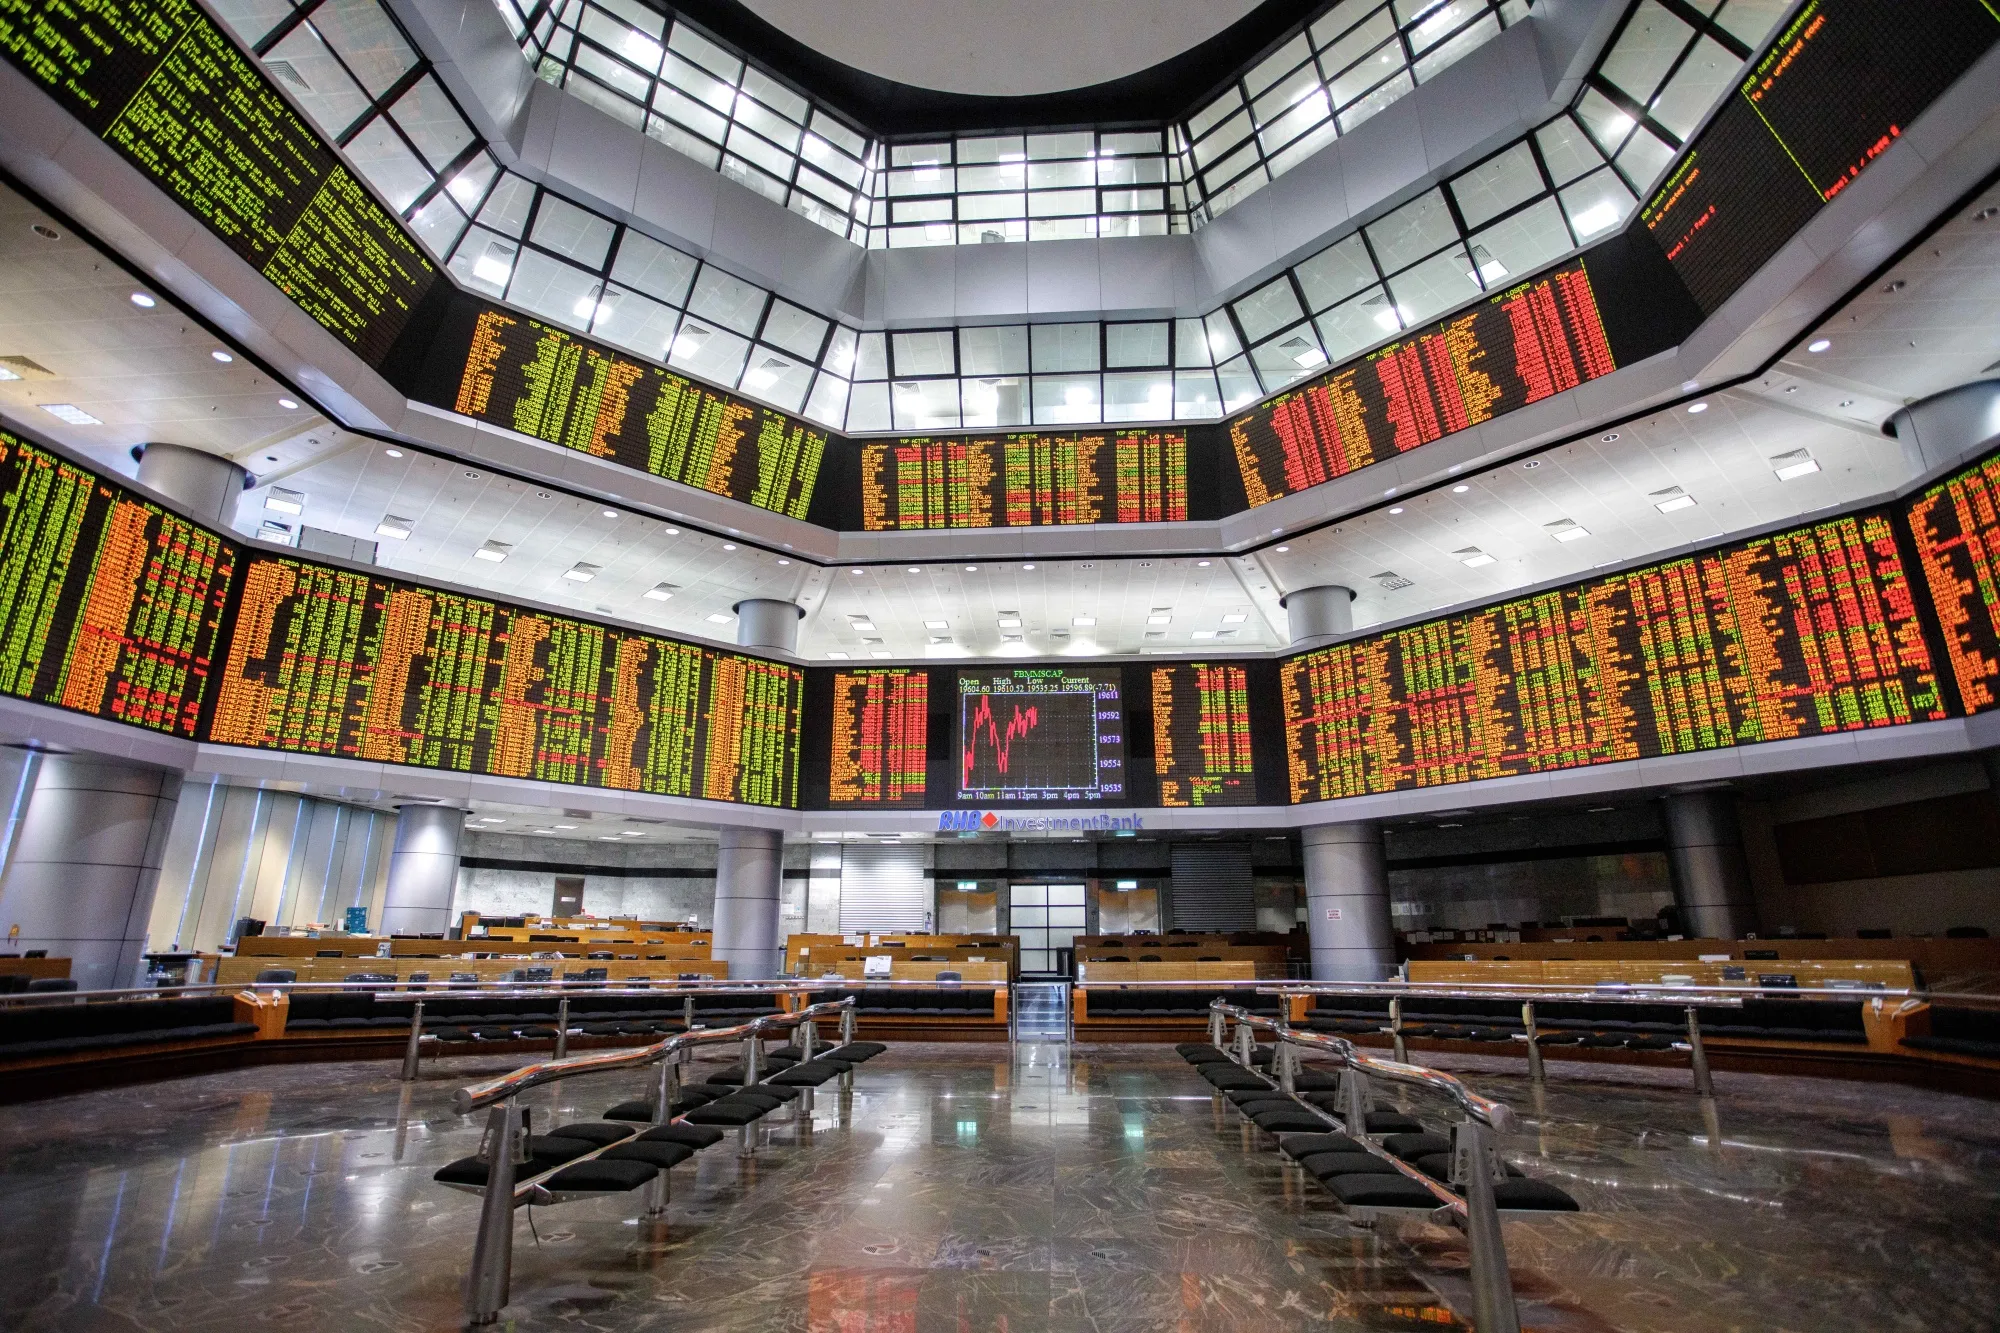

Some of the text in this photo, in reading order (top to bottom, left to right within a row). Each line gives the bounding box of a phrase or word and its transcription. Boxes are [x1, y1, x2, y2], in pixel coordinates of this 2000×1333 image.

[1743, 0, 1818, 92] RHB Asset Managemen
[1751, 15, 1825, 102] To be updated soon
[1648, 221, 1656, 230] To
[1655, 212, 1663, 221] be
[1685, 168, 1699, 186] soon
[1651, 189, 1666, 208] Asset
[1491, 282, 1530, 304] TOP LOSERS
[1451, 313, 1478, 328] Counter
[1511, 291, 1524, 300] Vol
[487, 311, 516, 325] Counter
[549, 334, 560, 342] Vol
[529, 320, 570, 340] TOP GAINERS
[1366, 343, 1400, 361] TOP LOSERS
[1333, 351, 1394, 382] Counter Vol
[59, 462, 95, 484] COUNTERS
[100, 487, 112, 498] Vol
[1731, 516, 1881, 558] Counter Vol
[1747, 538, 1770, 548] BURSA
[1773, 528, 1811, 542] MALAYSIA
[302, 564, 335, 575] MALAYSIA
[338, 571, 369, 582] COUNTERS
[1626, 567, 1658, 578] MALAYSIA
[1661, 558, 1694, 570] COUNTERS
[959, 678, 979, 686] Open
[993, 677, 1012, 685] High
[1100, 760, 1121, 768] 19554
[958, 791, 1101, 800] 9am 10am 11am 12pm 3pm 4pm 5pm
[1100, 784, 1121, 792] 19535
[939, 810, 982, 831] RHB
